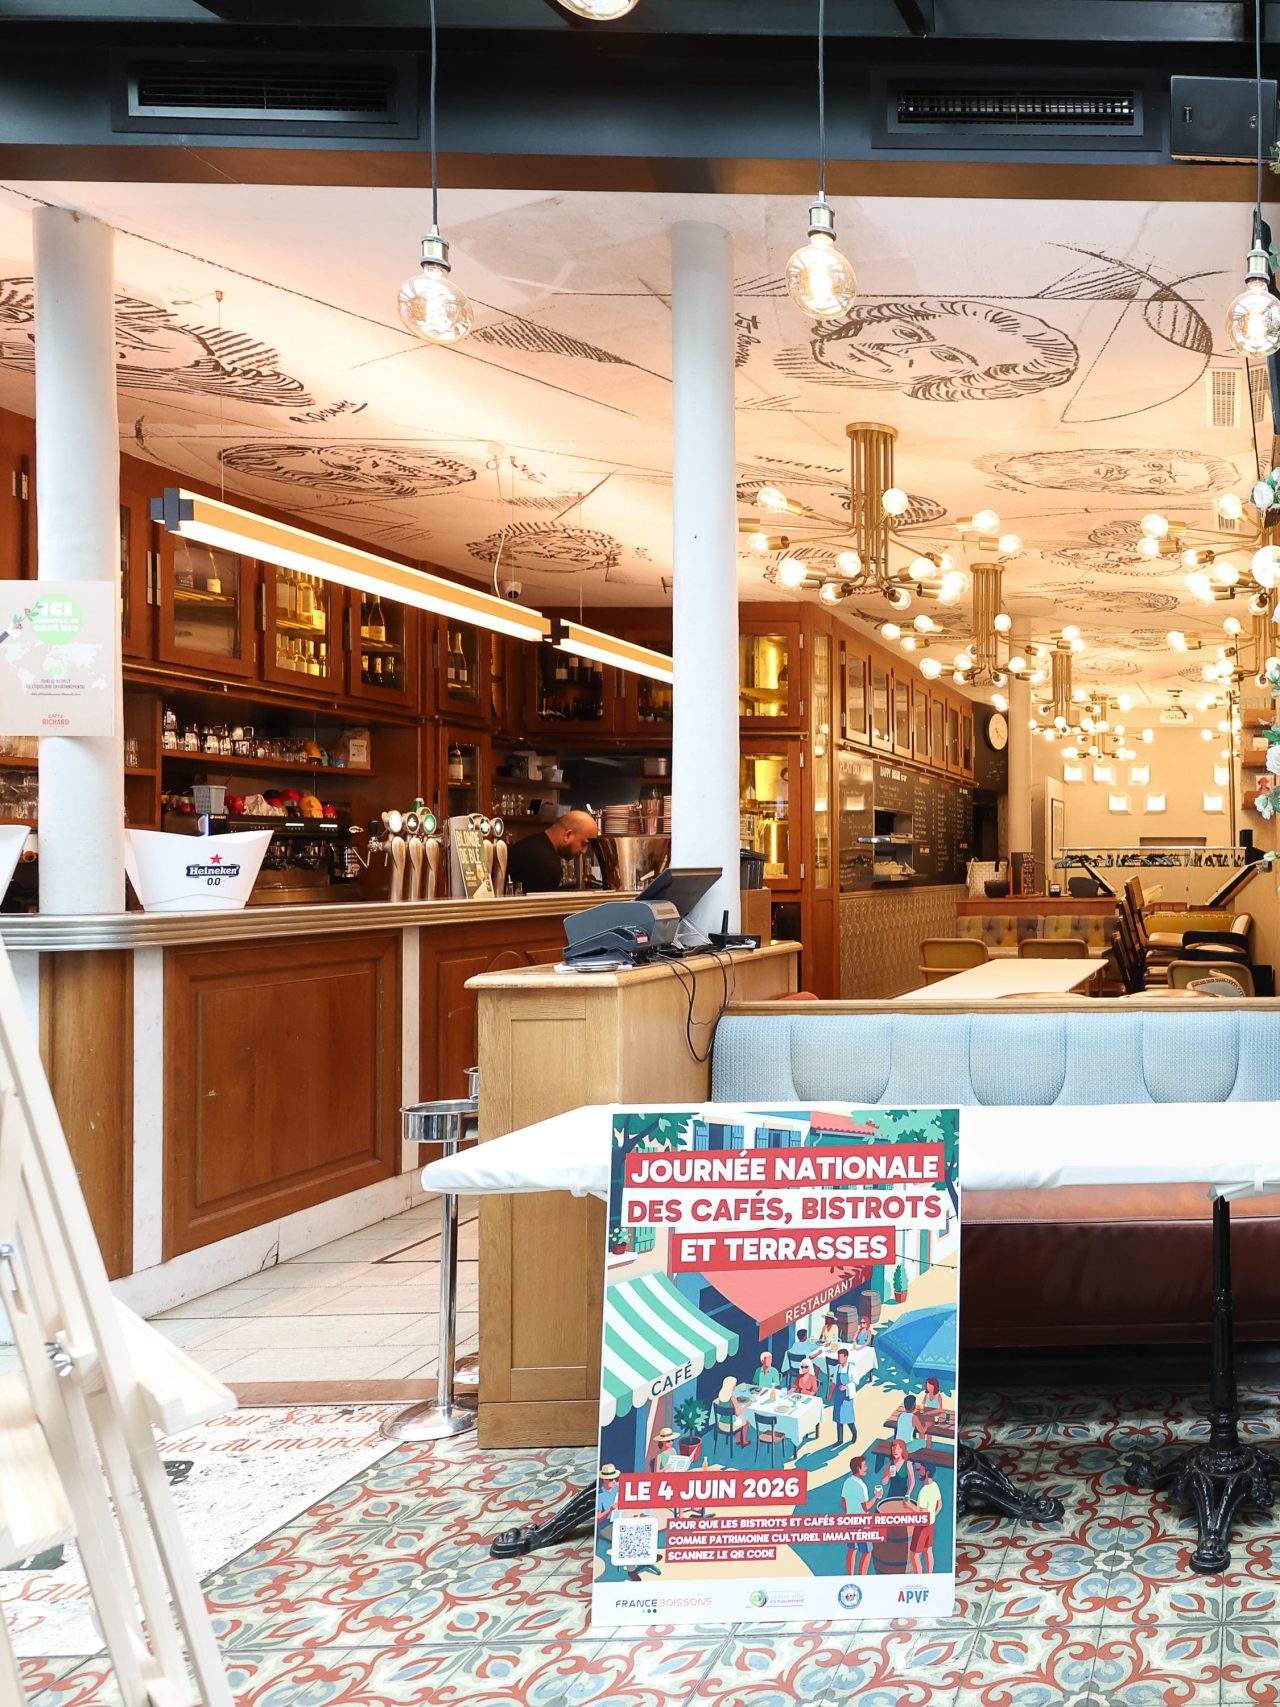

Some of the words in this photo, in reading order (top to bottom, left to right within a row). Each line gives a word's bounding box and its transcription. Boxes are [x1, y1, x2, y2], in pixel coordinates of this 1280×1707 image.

[42, 718, 69, 726] RICHARD
[456, 830, 481, 847] BLONDE
[460, 848, 469, 864] DE
[207, 877, 221, 886] 0.0
[631, 1150, 766, 1185] JOURNÉE
[774, 1154, 939, 1182] NATIONALE
[627, 1199, 682, 1224] DES
[691, 1190, 793, 1225] CAFÉS,
[801, 1194, 942, 1221] BISTROTS
[679, 1238, 717, 1262] ET
[723, 1234, 889, 1261] TERRASSES
[784, 1276, 855, 1324] RESTAURANT
[650, 1362, 693, 1398] CAFÉ
[624, 1480, 653, 1502] LE
[656, 1480, 675, 1499] 4
[679, 1478, 738, 1500] JUIN
[741, 1476, 800, 1499] 2026
[669, 1520, 696, 1530] POUR
[698, 1519, 719, 1529] QUE
[721, 1519, 738, 1528] LES
[740, 1518, 787, 1528] BISTROTS
[789, 1518, 802, 1526] ET
[804, 1514, 835, 1526] CAFÉS
[837, 1516, 872, 1525] SOIENT
[875, 1515, 928, 1524] RECONNUS
[668, 1535, 707, 1545] COMME
[709, 1533, 769, 1544] PATRIMOINE
[771, 1533, 820, 1542] CULTUREL
[823, 1529, 885, 1541] IMMATÉRIEL,
[667, 1551, 714, 1560] SCANNEZ
[717, 1550, 728, 1559] LE
[730, 1549, 744, 1559] QR
[746, 1549, 774, 1558] CODE
